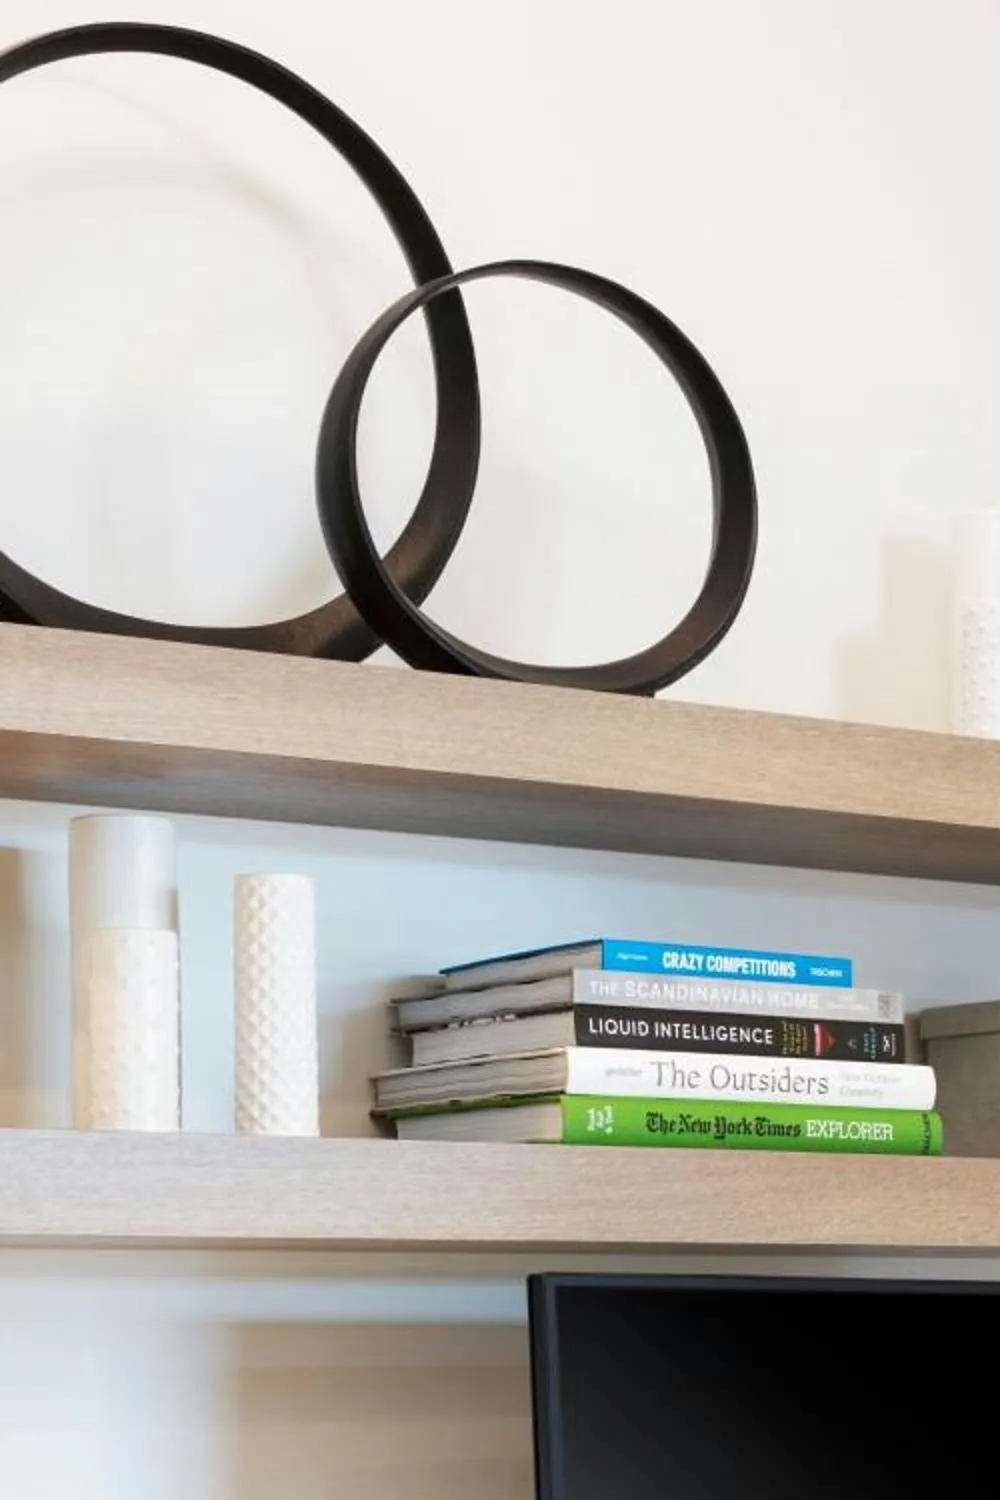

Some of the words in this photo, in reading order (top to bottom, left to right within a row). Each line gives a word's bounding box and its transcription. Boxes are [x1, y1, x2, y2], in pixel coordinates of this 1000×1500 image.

[662, 951, 704, 972] CRAZY
[707, 955, 796, 979] COMPETITIONS
[589, 980, 620, 998] THE
[625, 981, 764, 1006] SCANDINAVIAN
[768, 991, 819, 1008] HOME
[589, 1018, 649, 1037] LIQUID
[654, 1022, 774, 1044] INTELLIGENCE
[650, 1059, 702, 1089] The
[710, 1065, 829, 1095] Outsiders
[646, 1111, 677, 1133] The
[678, 1113, 712, 1135] New
[714, 1116, 754, 1139] York
[755, 1117, 802, 1138] Times
[806, 1119, 892, 1141] EXPLORER
